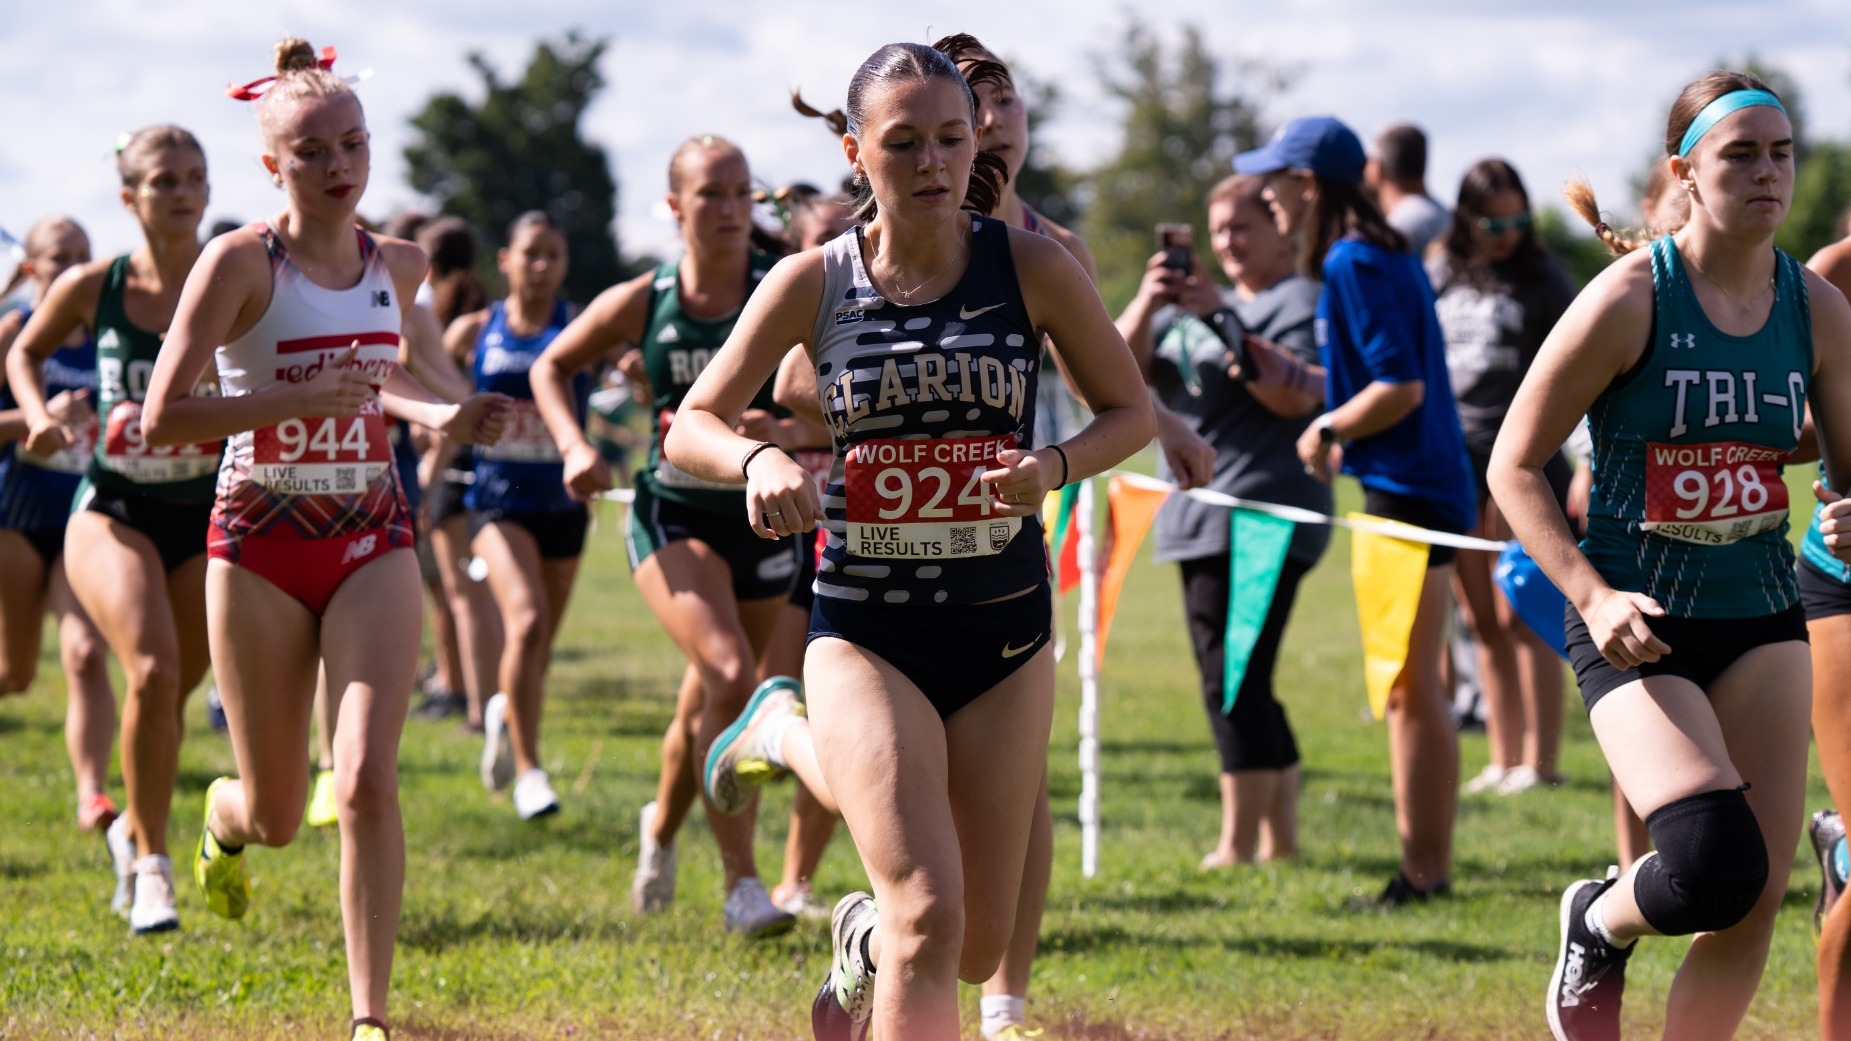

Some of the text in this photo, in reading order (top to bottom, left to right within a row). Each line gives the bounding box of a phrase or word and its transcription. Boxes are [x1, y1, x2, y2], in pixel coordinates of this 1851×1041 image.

[836, 310, 864, 320] PSAC
[823, 353, 1026, 437] CLARION
[1665, 369, 1805, 440] TRI-C
[276, 417, 370, 462] 944
[855, 439, 1009, 464] WOLF CREEK
[1655, 446, 1782, 467] WOLF CREEK
[264, 467, 297, 479] LIVE
[264, 478, 330, 492] RESULTS
[874, 465, 995, 520] 924
[1673, 464, 1769, 519] 928
[860, 527, 900, 541] LIVE
[341, 534, 377, 564] NB
[860, 541, 943, 556] RESULTS
